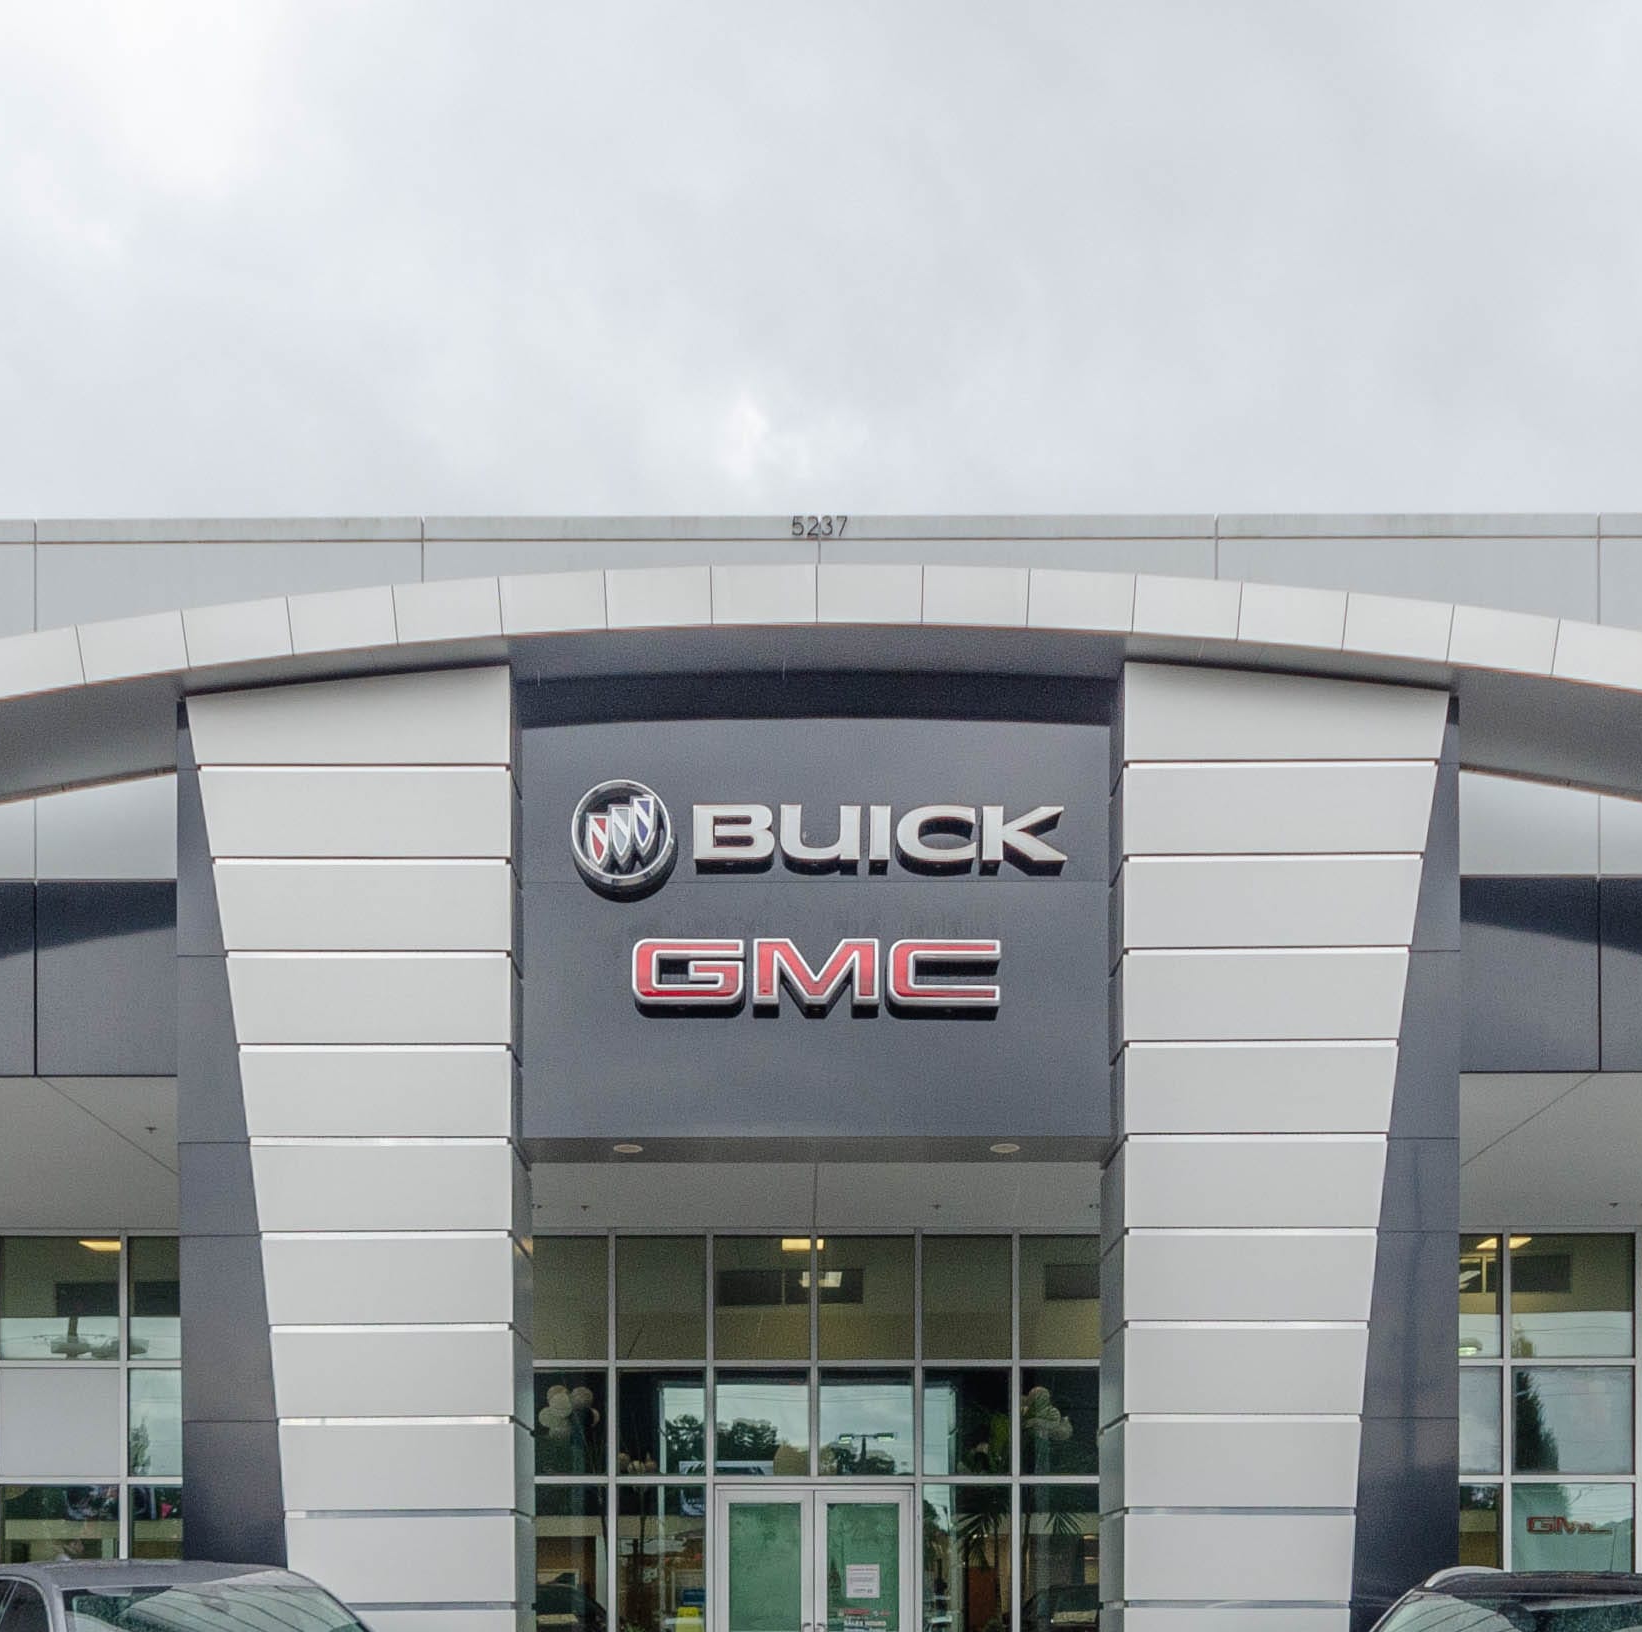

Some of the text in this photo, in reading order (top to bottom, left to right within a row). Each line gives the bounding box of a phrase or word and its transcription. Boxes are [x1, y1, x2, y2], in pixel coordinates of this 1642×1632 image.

[791, 515, 848, 536] 5237
[692, 804, 1068, 870] BUICK
[632, 938, 1001, 1010] GMC
